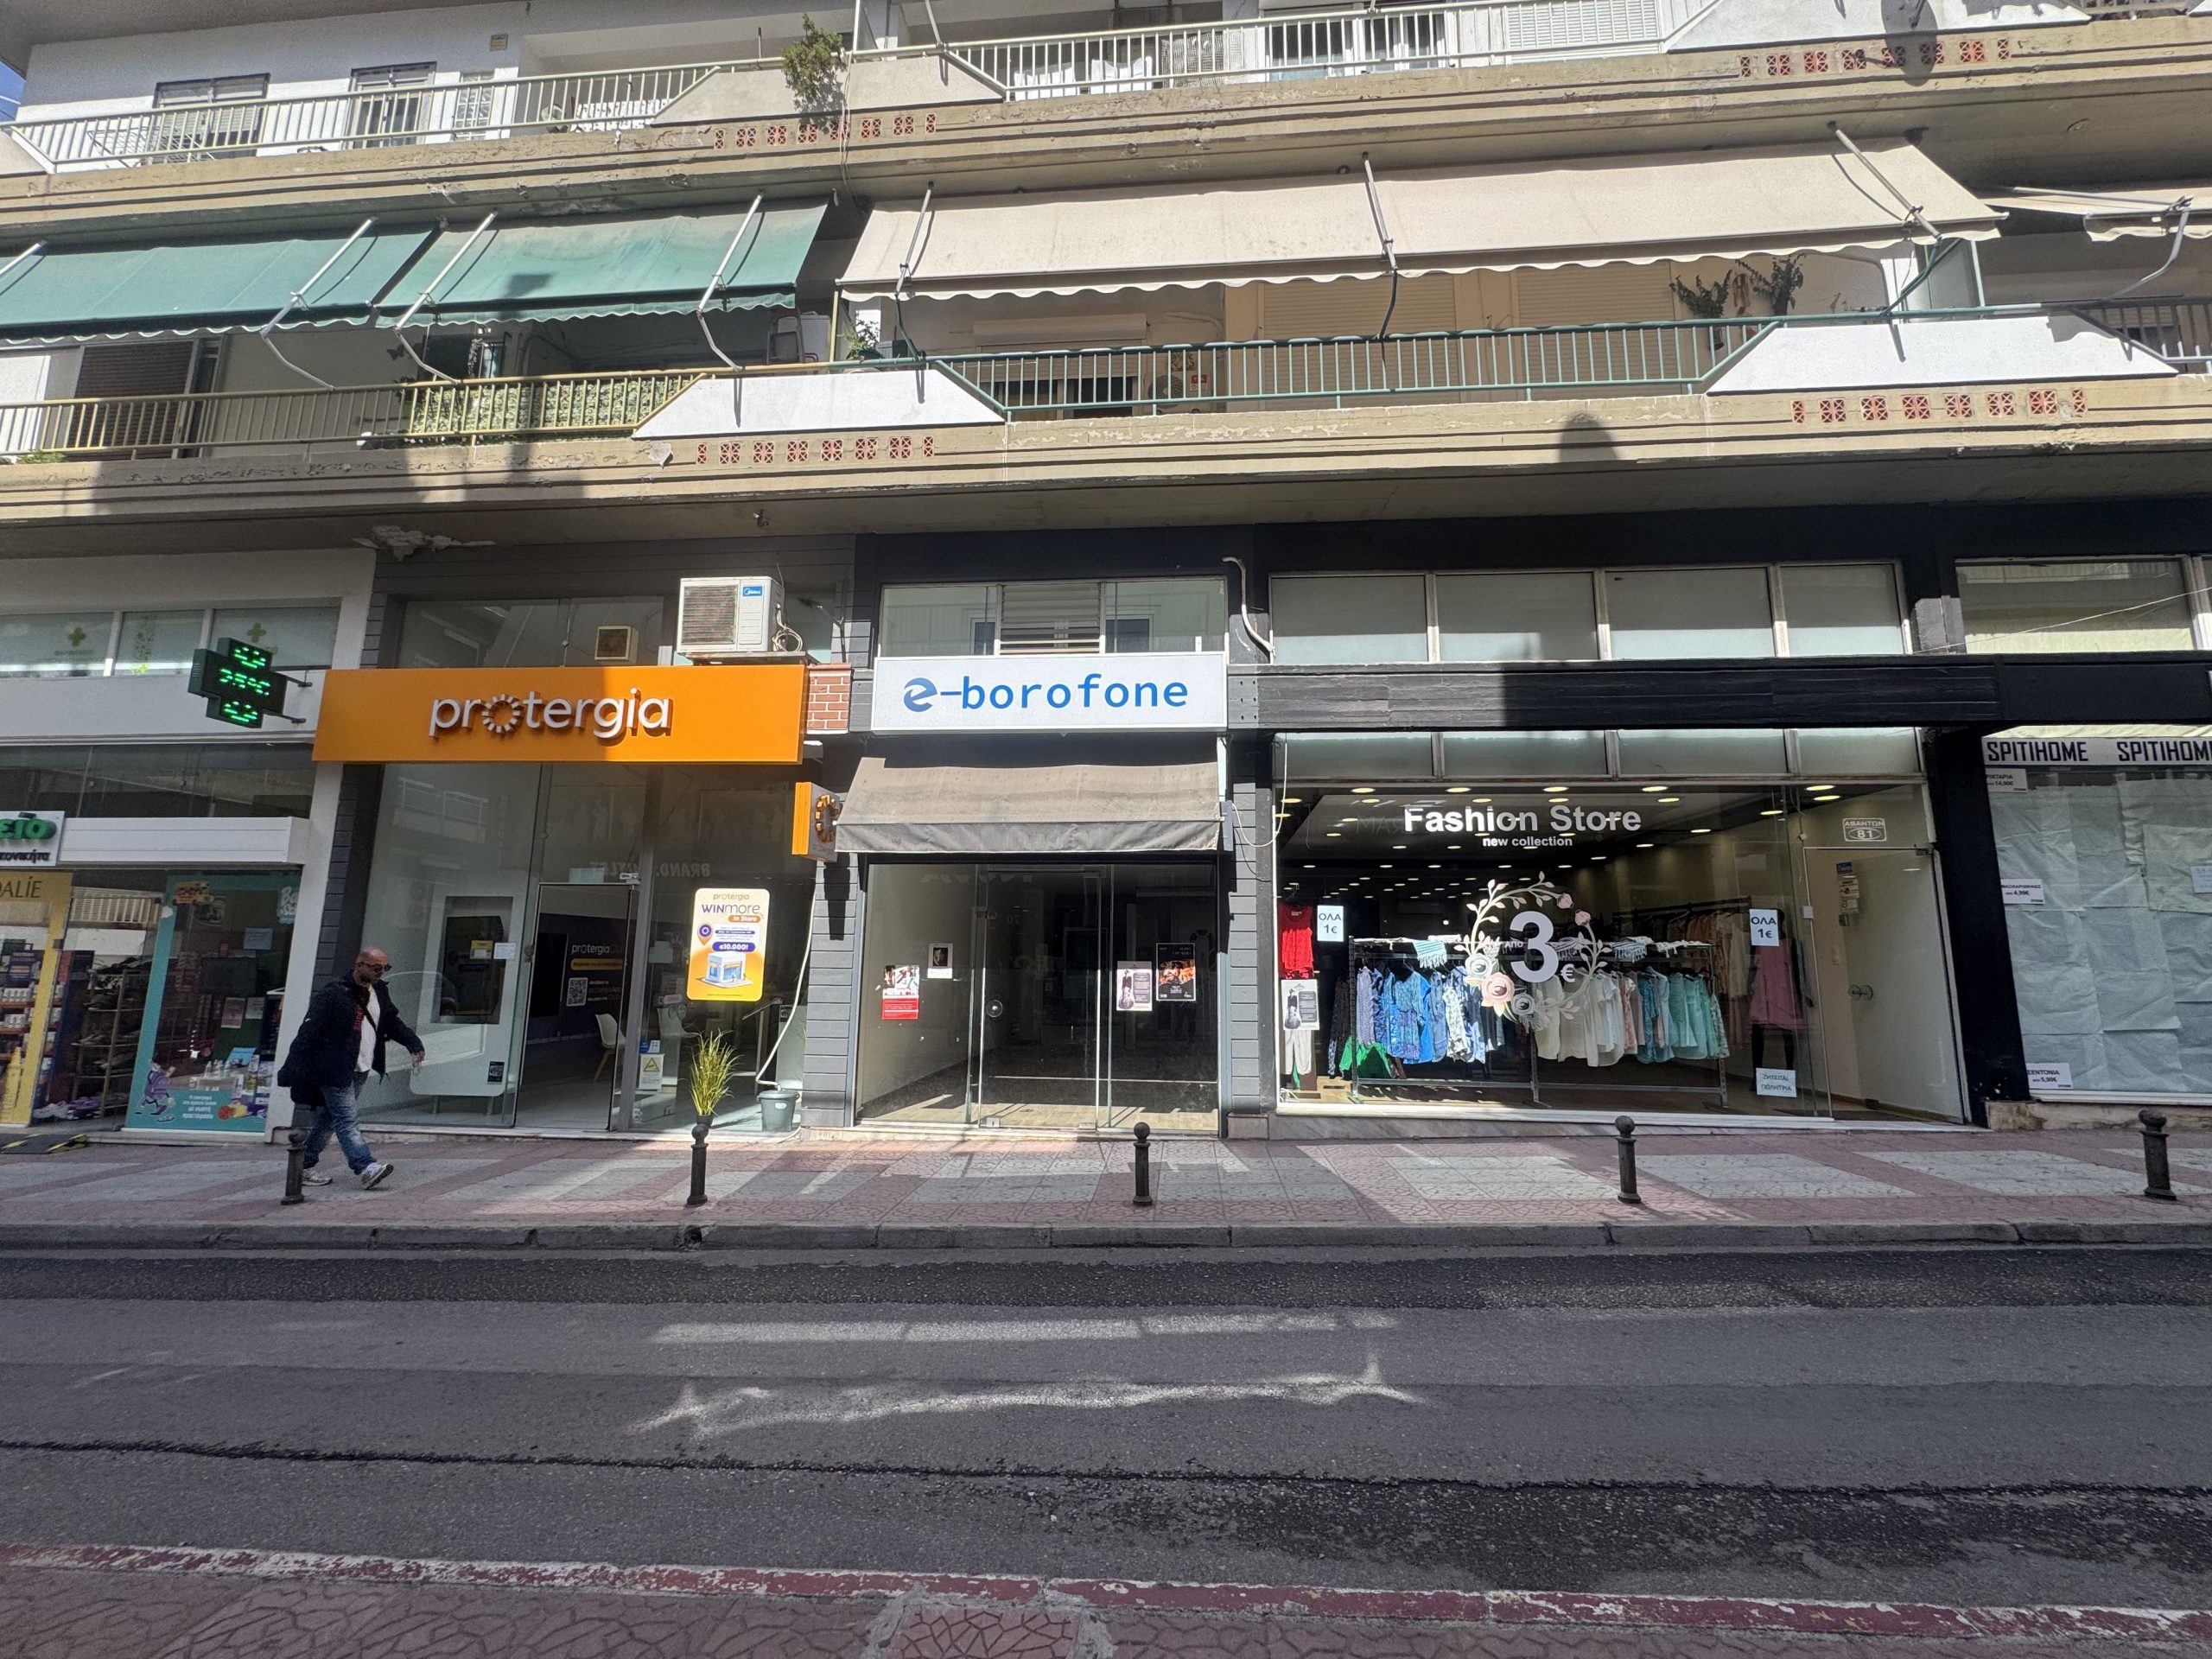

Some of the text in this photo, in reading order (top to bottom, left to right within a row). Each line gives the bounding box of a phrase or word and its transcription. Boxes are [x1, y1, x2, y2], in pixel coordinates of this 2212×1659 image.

[904, 673, 1188, 712] e-borofone
[429, 688, 673, 739] protergia
[1986, 741, 2089, 761] SPITIHOME
[1404, 806, 1538, 832] Fashion
[1550, 804, 1642, 831] Store
[1483, 836, 1573, 847] new collection
[1857, 830, 1873, 838] 81
[0, 876, 41, 898] ALÍE
[702, 904, 760, 914] WINmore
[1325, 925, 1338, 934] 1€
[1758, 929, 1773, 938] 1€
